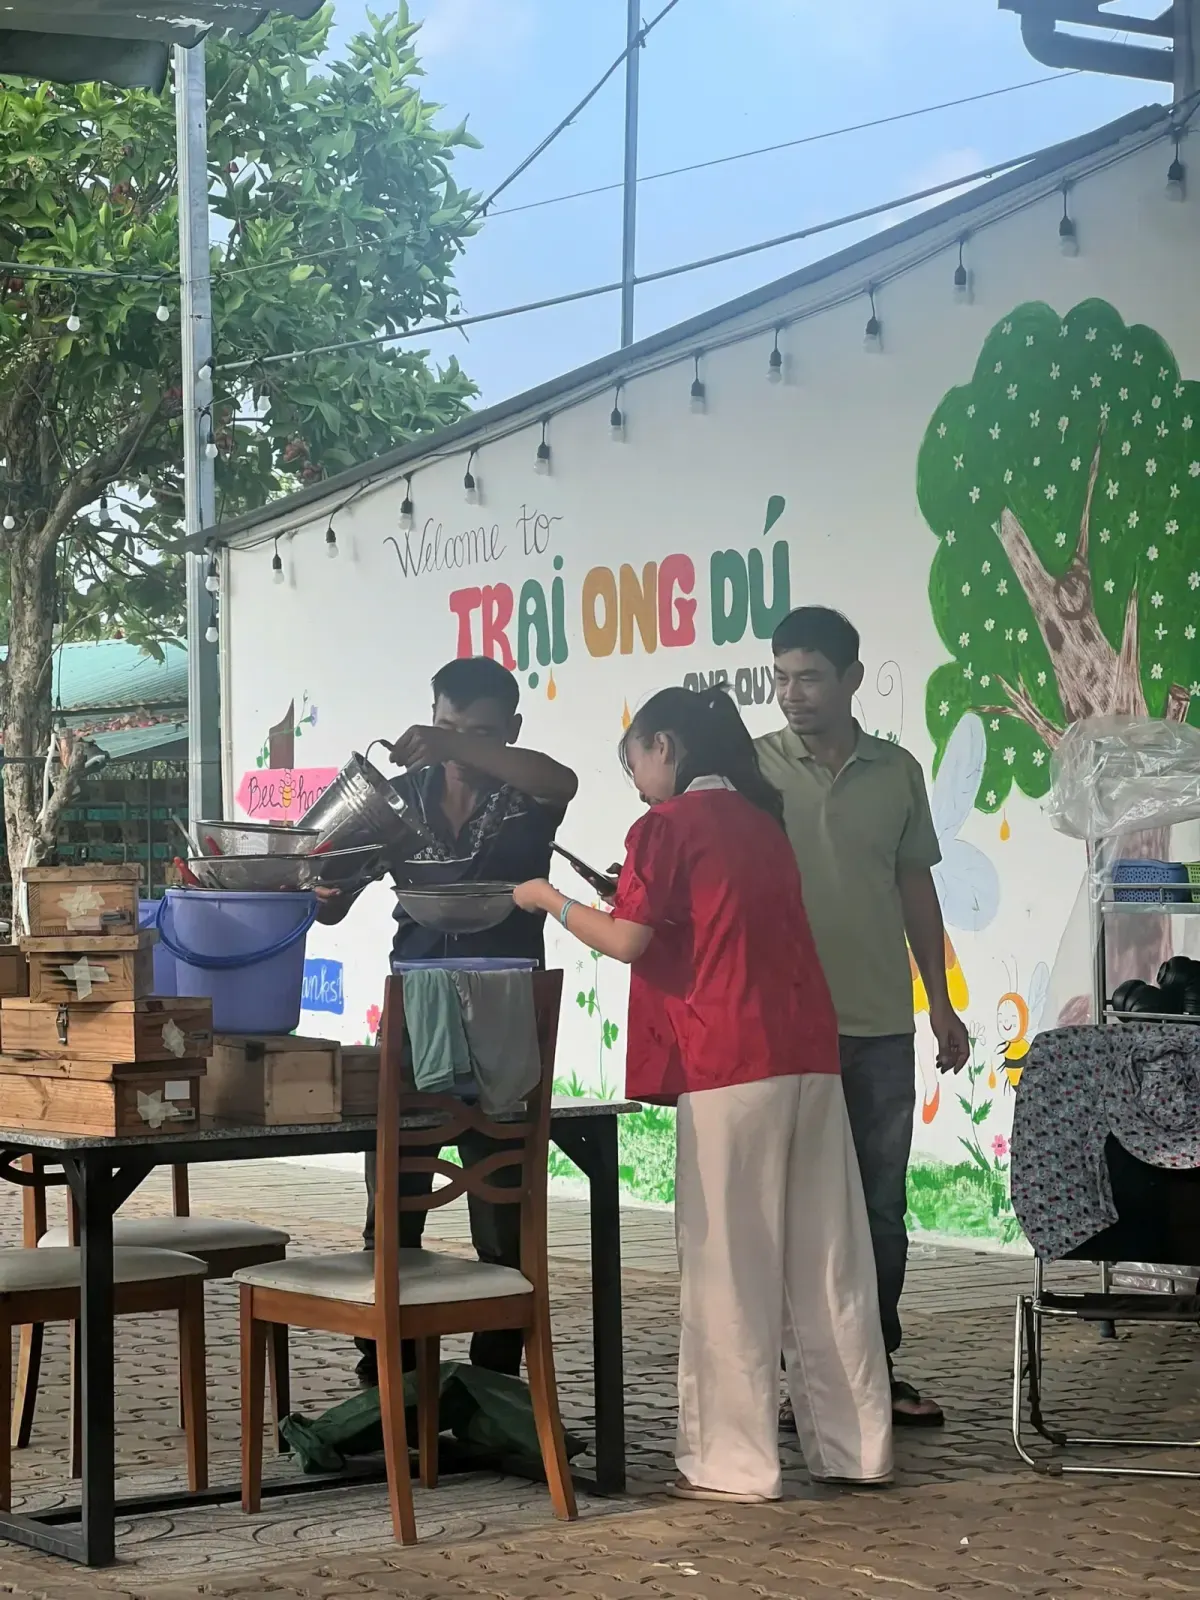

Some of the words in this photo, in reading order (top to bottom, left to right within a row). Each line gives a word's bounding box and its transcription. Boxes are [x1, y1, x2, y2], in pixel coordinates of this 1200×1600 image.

[383, 518, 507, 577] Welcome
[516, 504, 564, 555] to
[582, 553, 697, 657] ONG
[710, 495, 791, 645] DÚ
[247, 776, 283, 816] Bee
